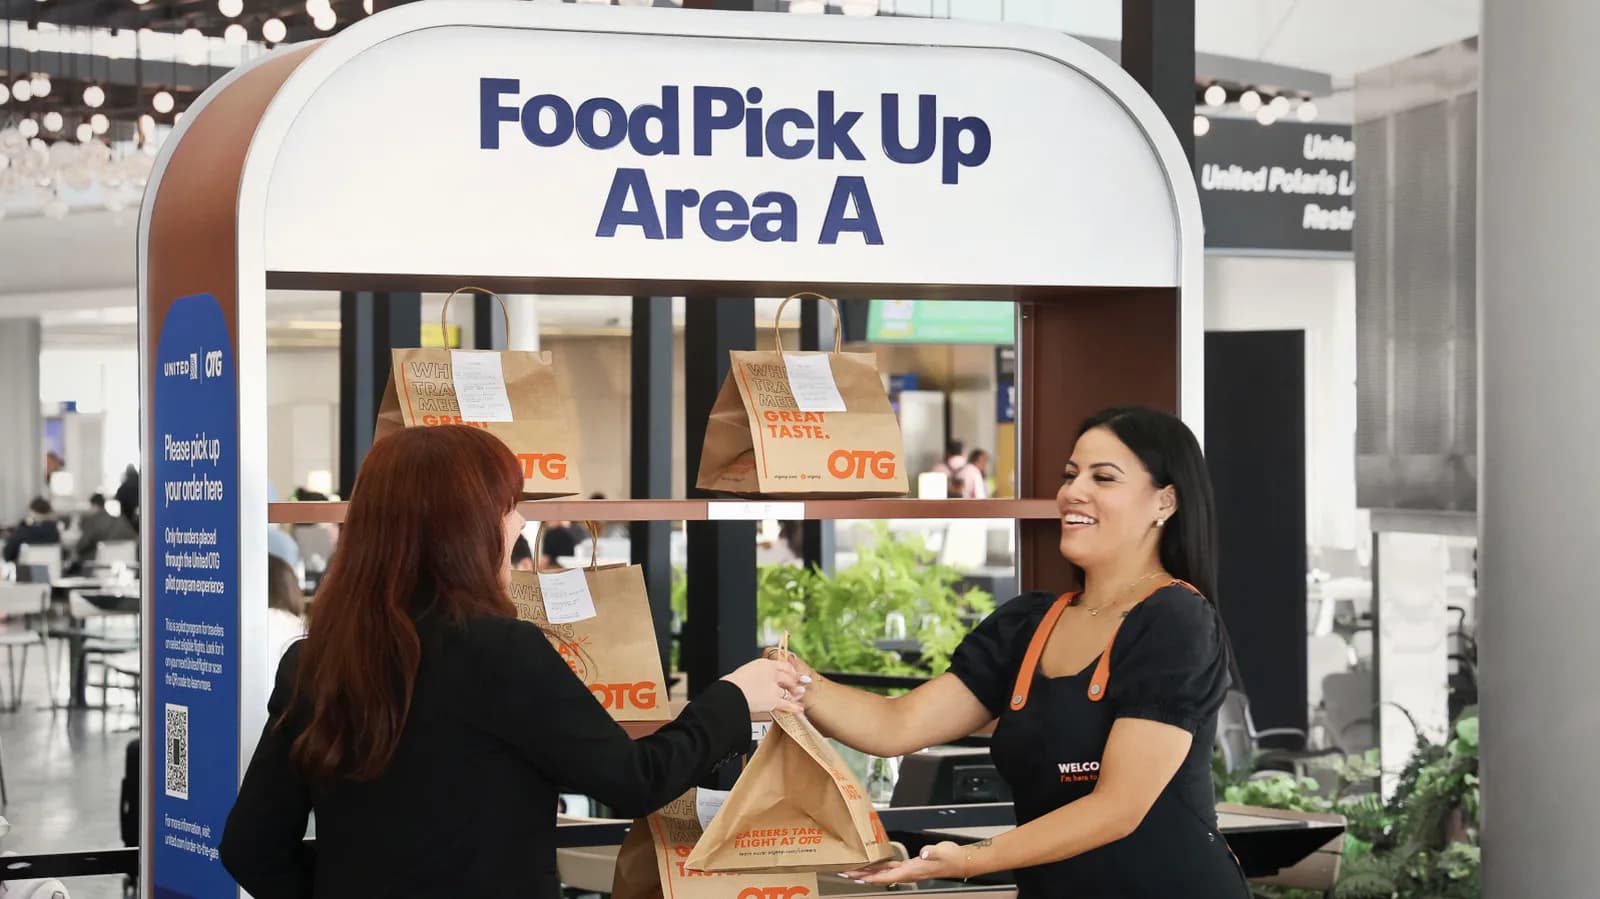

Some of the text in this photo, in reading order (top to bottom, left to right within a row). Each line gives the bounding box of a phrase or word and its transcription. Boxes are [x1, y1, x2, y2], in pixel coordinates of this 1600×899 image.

[480, 77, 991, 185] Food Pick Up
[1201, 163, 1268, 193] United
[1268, 166, 1338, 196] Polaris
[595, 167, 884, 245] Area A
[164, 350, 223, 378] UNITED OTG
[763, 410, 825, 423] GREAT
[767, 424, 830, 440] TASTE.
[164, 431, 220, 467] Please pick up
[516, 453, 566, 480] TG
[827, 449, 896, 480] OTG
[164, 473, 223, 508] your order here
[165, 527, 217, 549] Only for orders placed
[165, 551, 220, 571] through the United OTG
[165, 574, 224, 597] pilot program experience
[734, 836, 822, 848] FLIGHT AT OTG
[792, 826, 824, 836] TAKE
